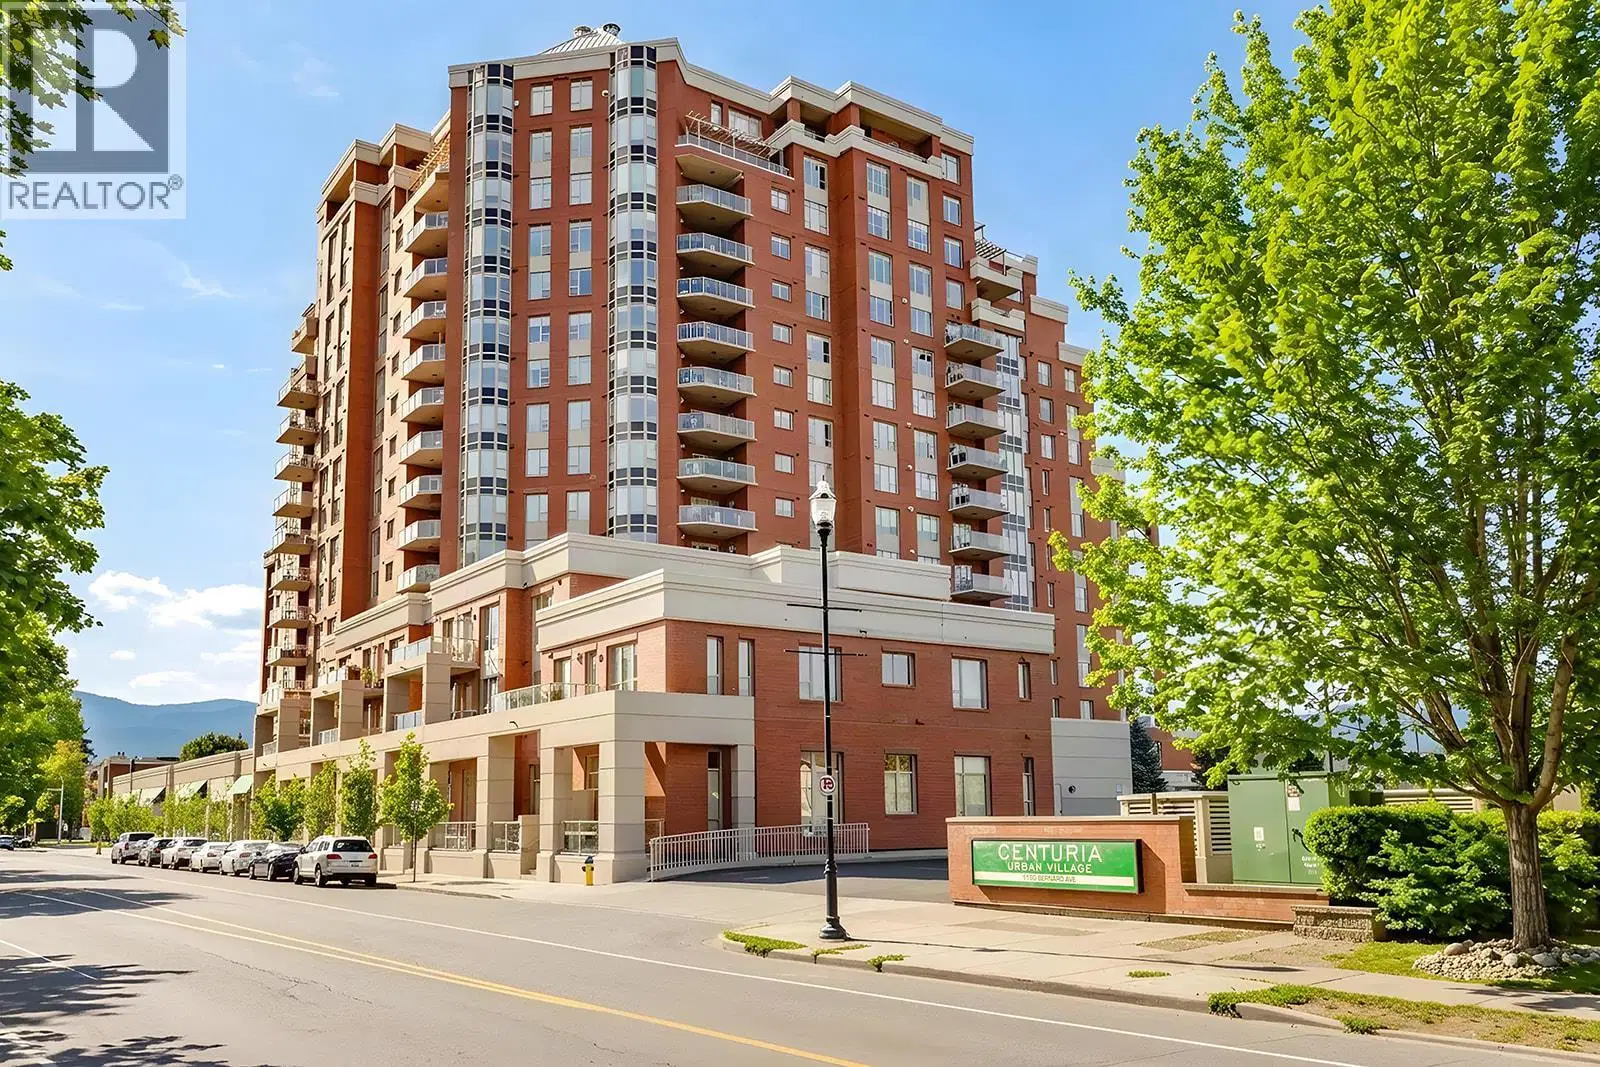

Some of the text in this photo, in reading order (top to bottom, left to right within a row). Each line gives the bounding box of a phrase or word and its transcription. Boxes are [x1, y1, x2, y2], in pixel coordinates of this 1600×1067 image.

[998, 843, 1103, 862] CENTURIA
[1007, 861, 1093, 874] URBAN VILLAGE
